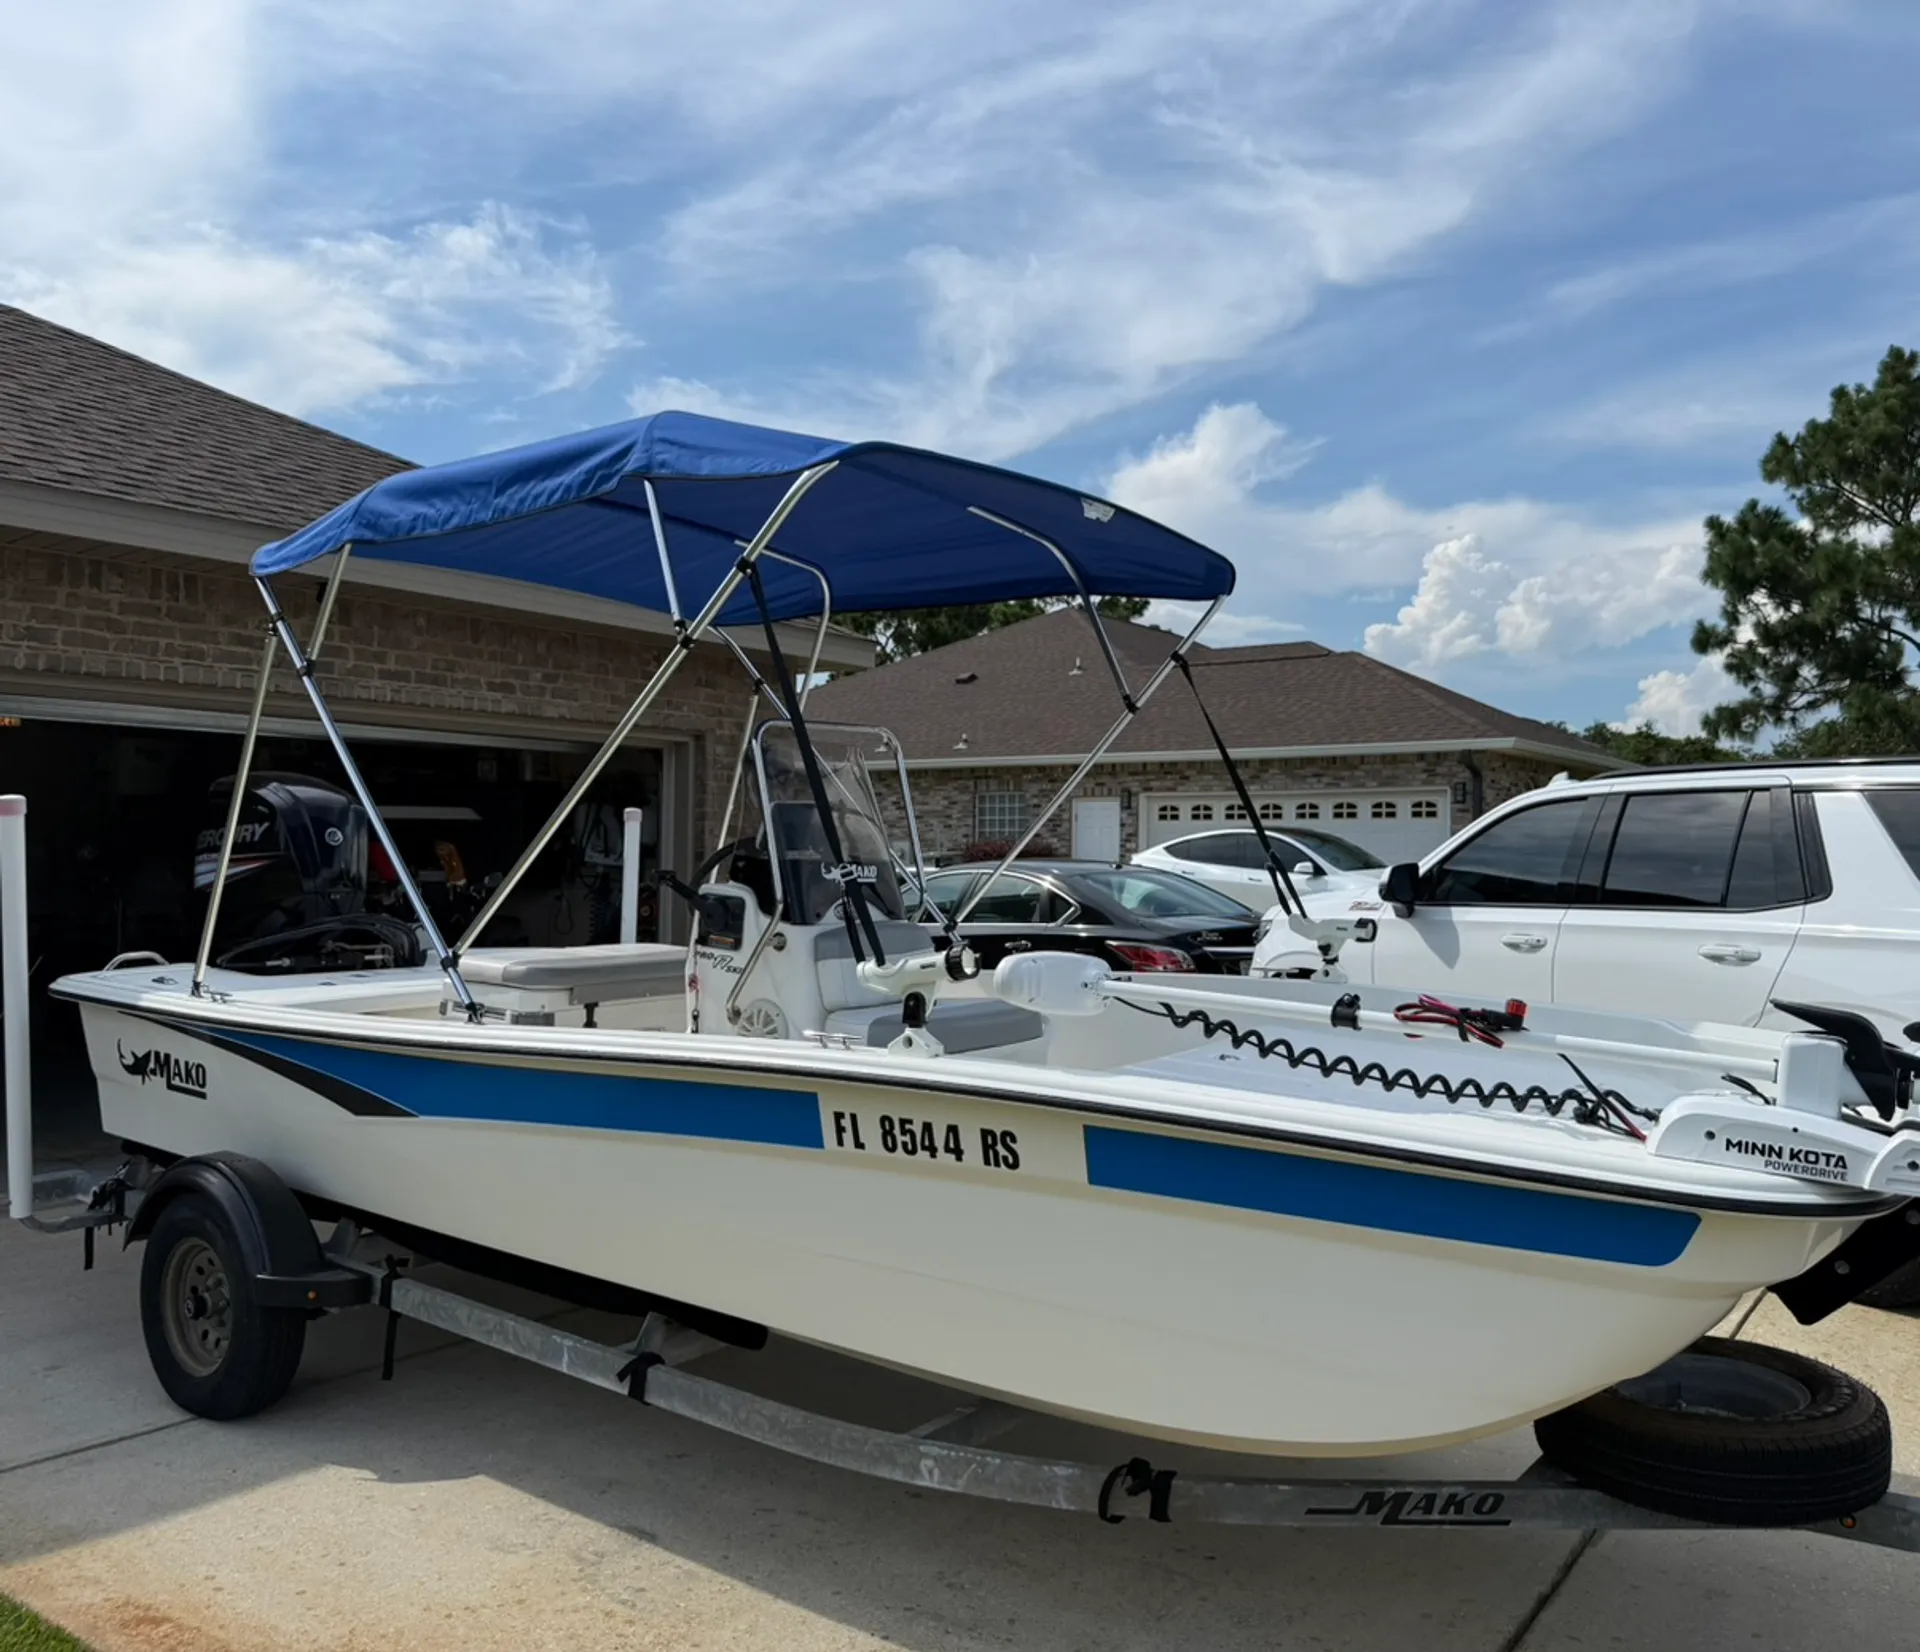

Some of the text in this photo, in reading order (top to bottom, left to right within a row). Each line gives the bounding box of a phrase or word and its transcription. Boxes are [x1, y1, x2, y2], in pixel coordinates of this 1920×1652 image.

[152, 1049, 208, 1101] MAKO
[833, 1110, 1021, 1171] FL 8544 RS
[1725, 1137, 1848, 1170] MINN KOTA
[1764, 1159, 1849, 1182] POWERDRIVE
[1305, 1491, 1513, 1526] MAKO
